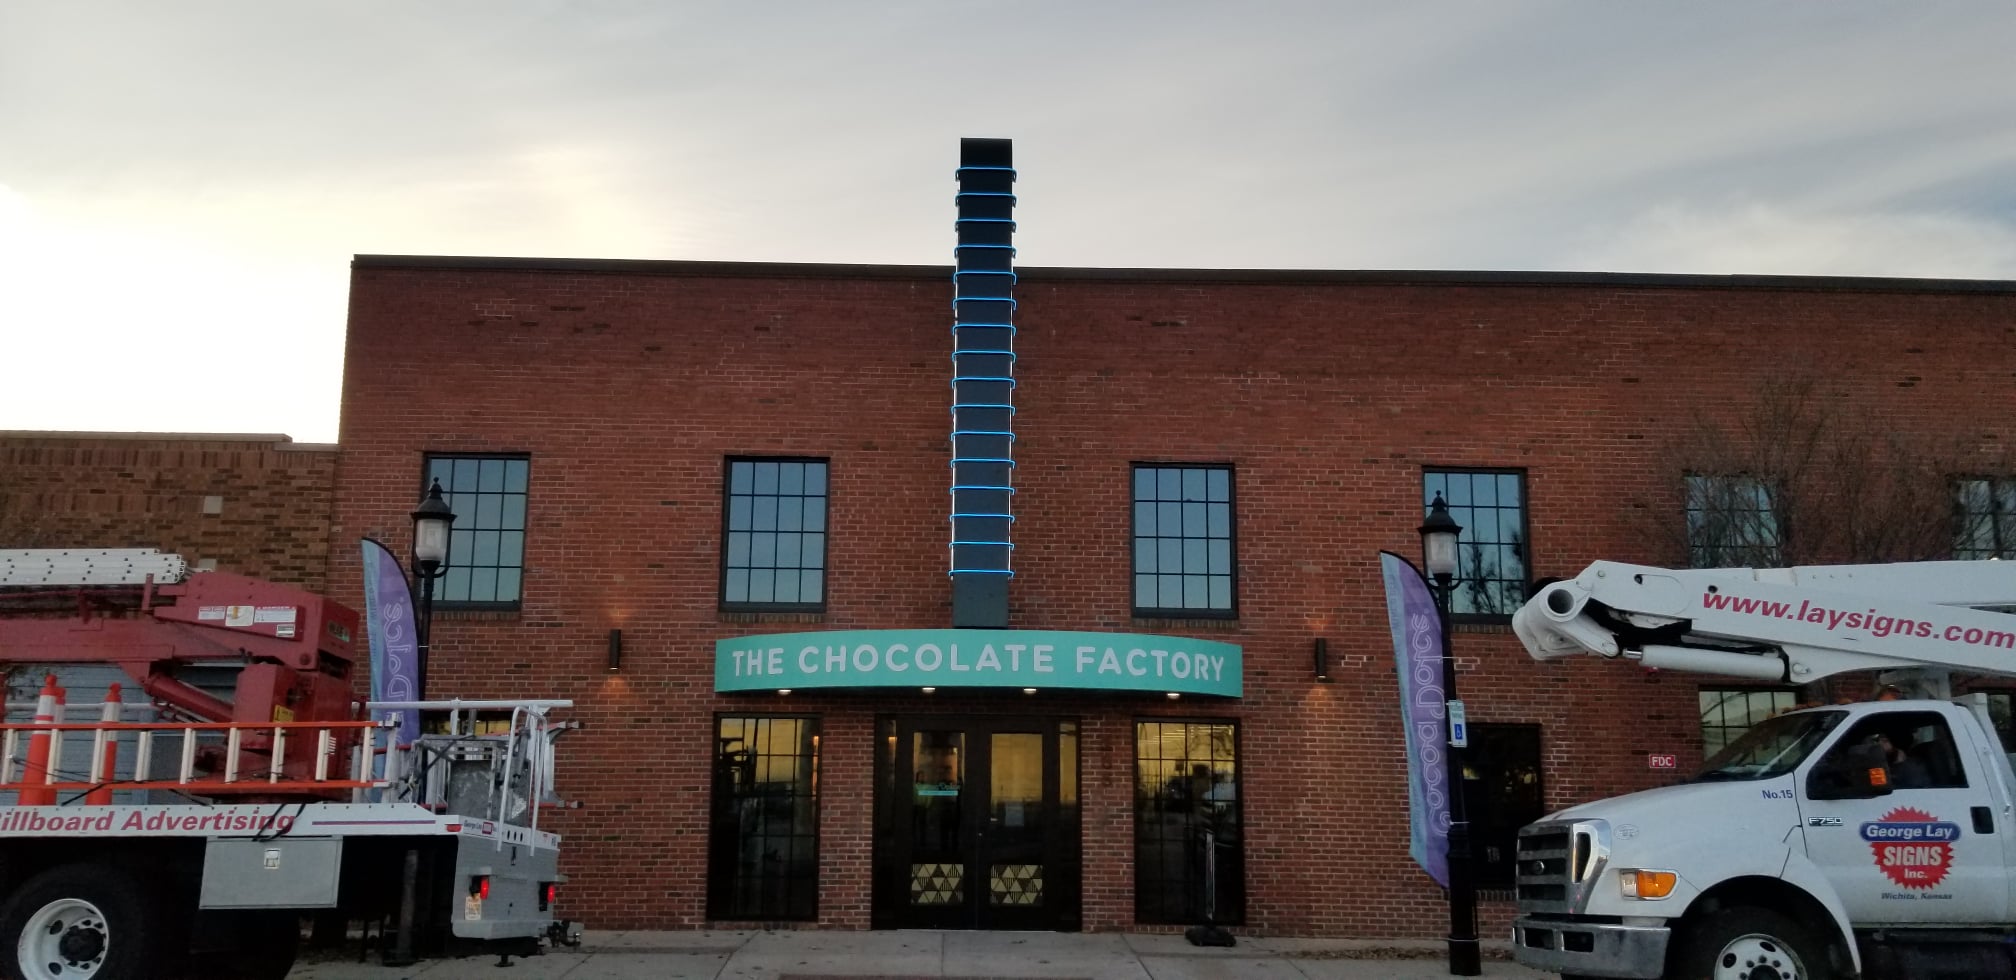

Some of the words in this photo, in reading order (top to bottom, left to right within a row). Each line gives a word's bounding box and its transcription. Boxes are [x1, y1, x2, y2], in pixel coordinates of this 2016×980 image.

[1703, 592, 2016, 649] www.laysigns.com
[732, 647, 784, 677] THE
[798, 643, 1055, 673] CHOCOLATE
[1075, 646, 1225, 682] FACTORY
[1651, 756, 1673, 767] FDC
[1762, 789, 1794, 800] No.15
[0, 810, 115, 832] illboard
[121, 811, 295, 833] Advertising
[1808, 816, 1844, 826] F750
[1866, 824, 1923, 840] George
[1926, 824, 1953, 839] Lay
[1882, 845, 1943, 867] SIGNS
[1904, 868, 1929, 879] Inc.
[1920, 892, 1953, 900] Kansas
